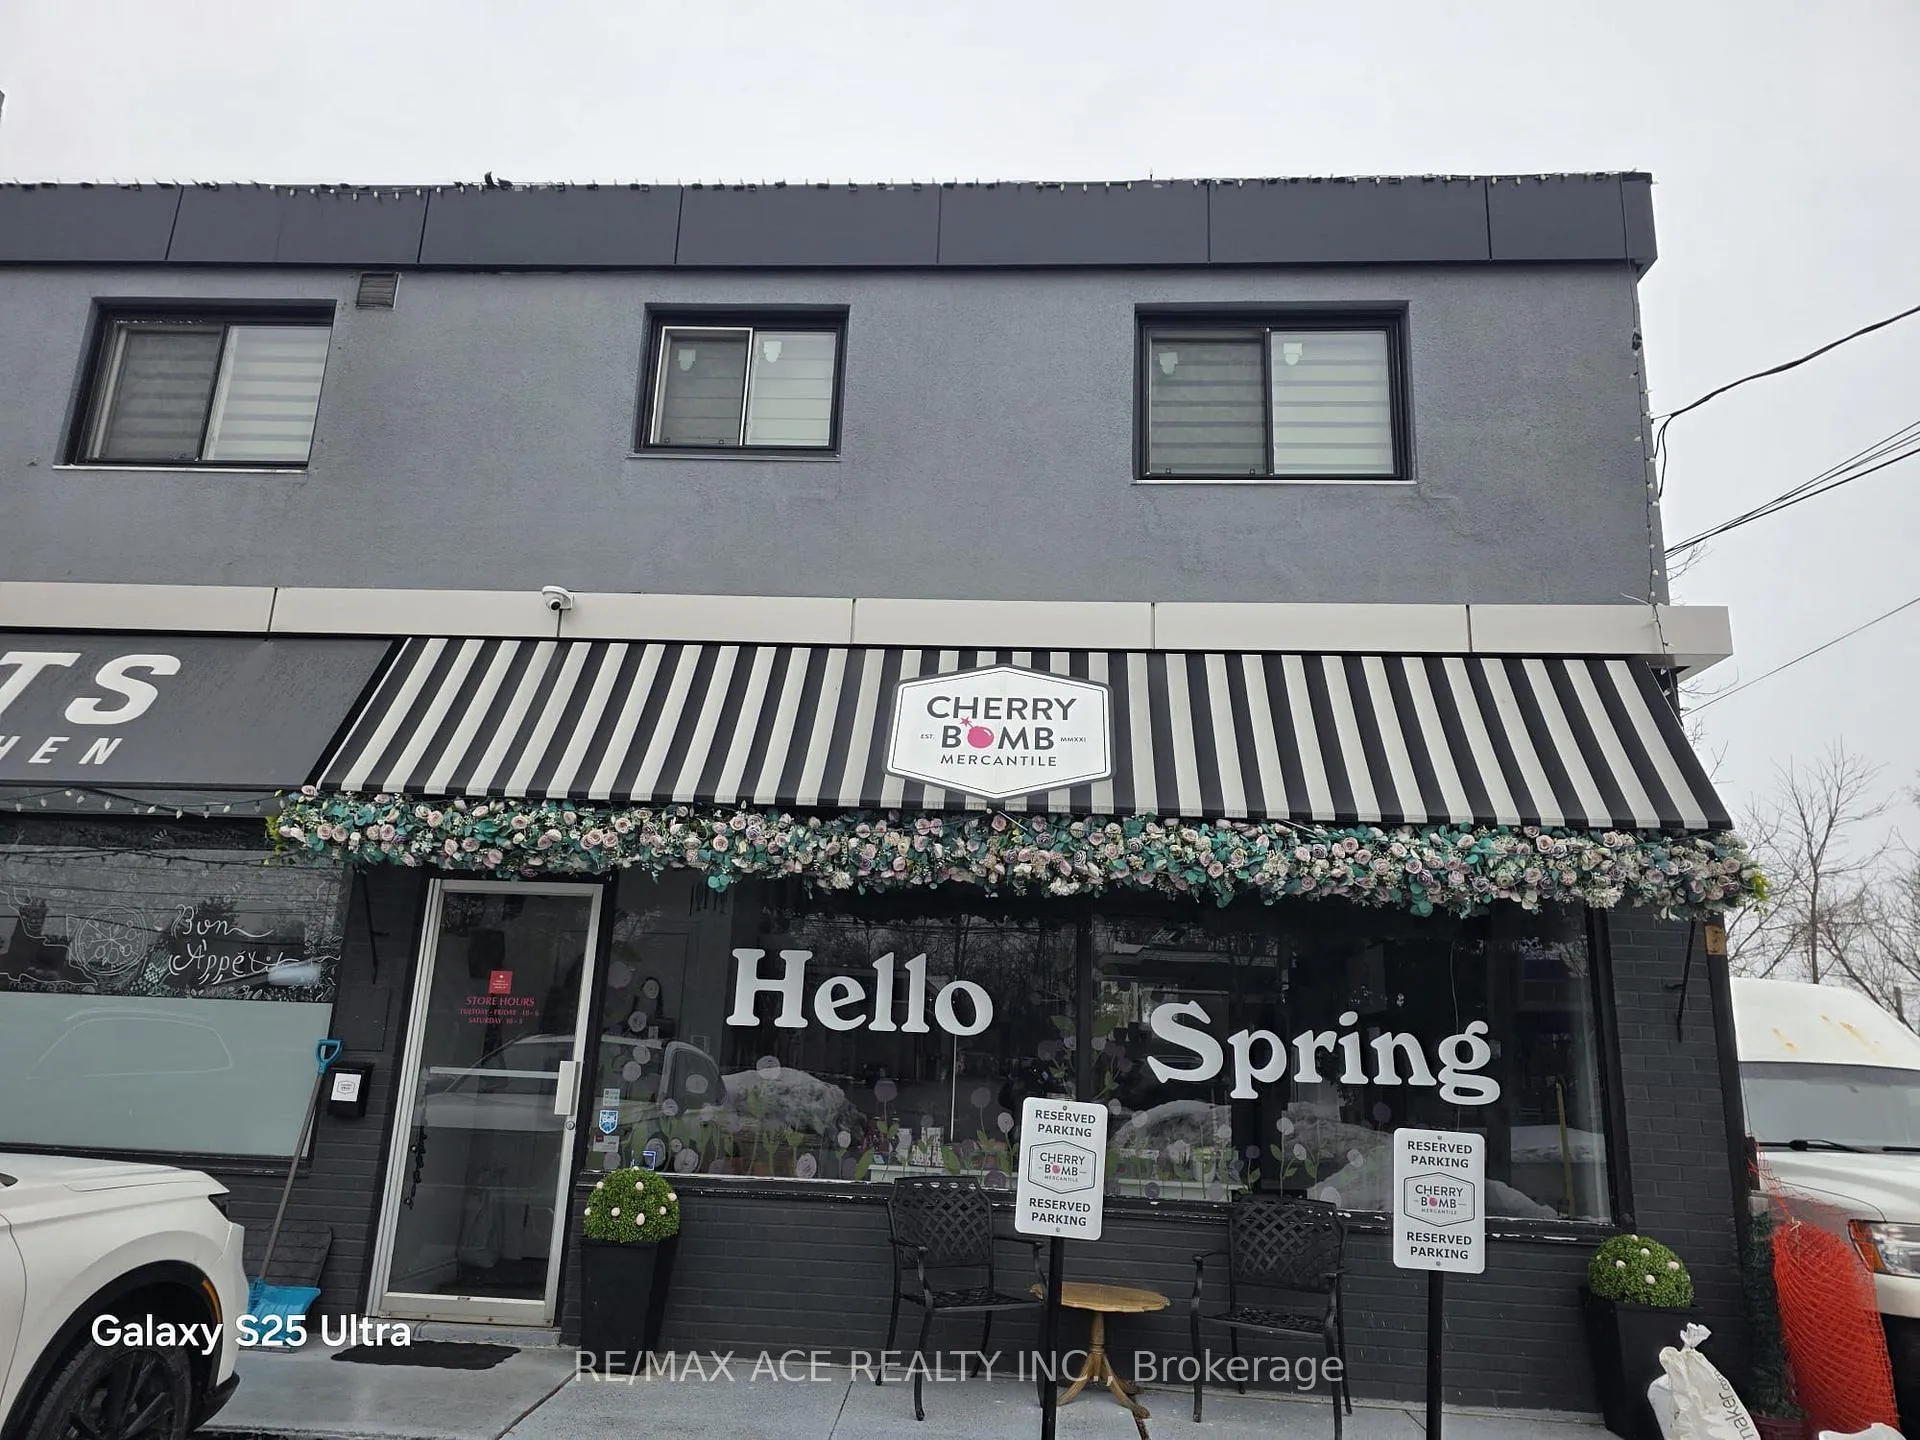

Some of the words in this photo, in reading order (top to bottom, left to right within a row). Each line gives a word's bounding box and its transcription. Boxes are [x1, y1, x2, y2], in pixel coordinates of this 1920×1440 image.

[926, 695, 1077, 721] CHERRY
[941, 725, 1055, 751] BOMB
[940, 754, 1057, 767] MERCANTILE
[171, 904, 274, 939] Bon
[725, 948, 994, 1037] Hello
[465, 996, 498, 1006] STORE
[500, 997, 535, 1007] HOURS
[1147, 1000, 1501, 1106] Spring
[1035, 1109, 1096, 1124] RESERVED
[1037, 1124, 1092, 1138] PARKING
[1407, 1140, 1472, 1154] RESERVED
[1040, 1152, 1085, 1166] CHERRY
[1411, 1155, 1469, 1168] PARKING
[1415, 1184, 1463, 1197] CHERRY
[1029, 1197, 1091, 1213] RESERVED
[1031, 1212, 1087, 1227] PARKING
[1406, 1231, 1472, 1246] RESERVED
[1410, 1246, 1469, 1260] PARKING
